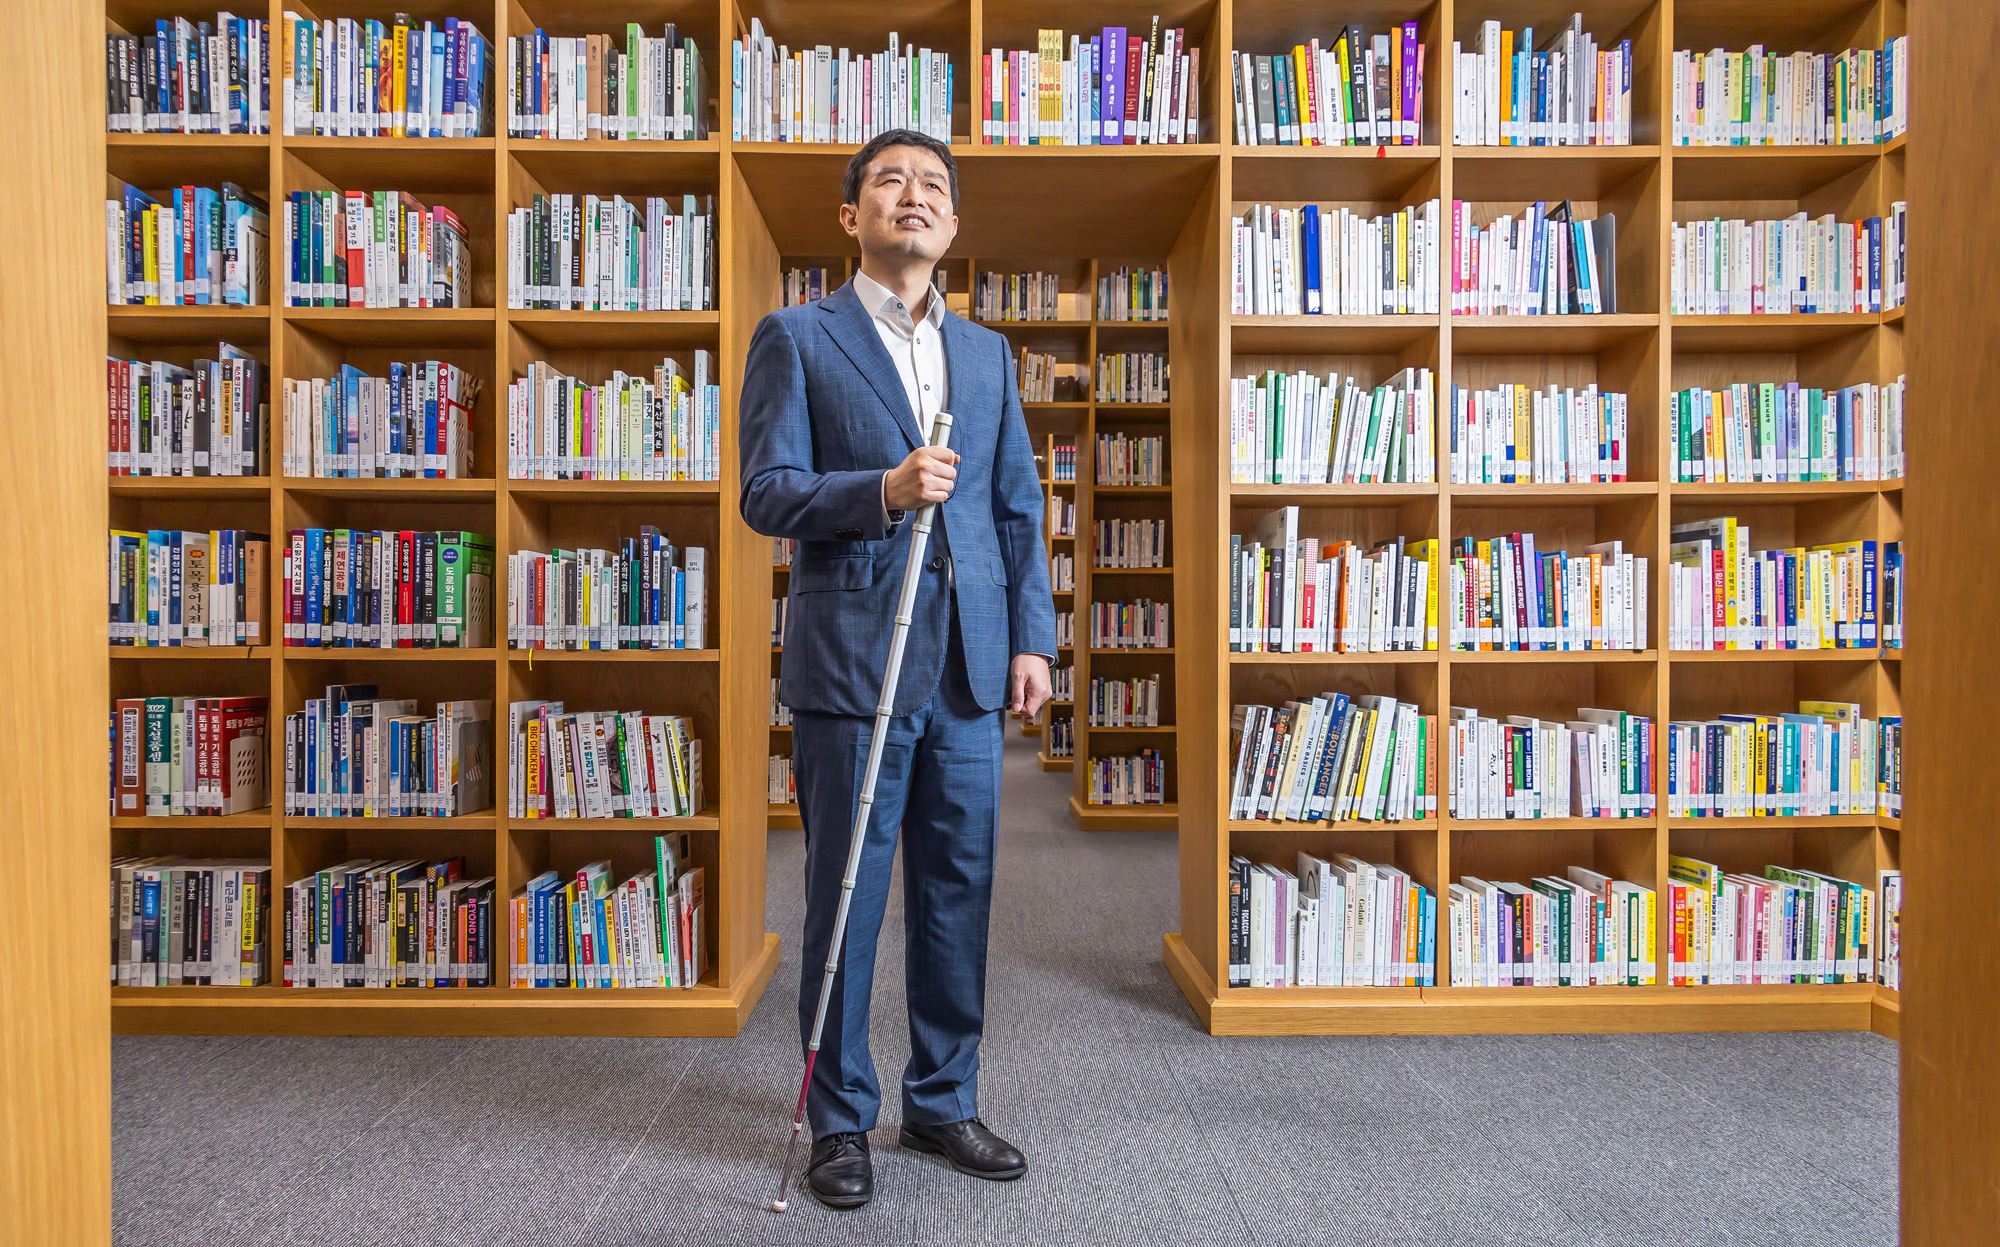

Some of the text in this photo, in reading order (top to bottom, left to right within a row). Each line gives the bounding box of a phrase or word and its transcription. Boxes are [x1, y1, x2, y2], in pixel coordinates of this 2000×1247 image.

[1149, 21, 1158, 68] CHAMPAGNE
[294, 542, 302, 593] 소방기계시설론
[336, 551, 345, 591] 제연공학
[188, 560, 204, 624] 토목용어사전
[445, 567, 454, 613] 도로와 교통
[147, 704, 166, 713] 2022
[198, 715, 208, 731] 토질
[211, 716, 220, 731] 토질
[148, 721, 163, 762] 건설품셈
[198, 743, 208, 776] 기초공학
[211, 743, 220, 777] 기초공학
[1373, 721, 1388, 765] TRAVEL CAKE
[1301, 752, 1311, 776] BASICS
[225, 880, 234, 928] 철근콘크리트
[468, 898, 476, 934] BEYOND
[409, 926, 414, 934] WE
